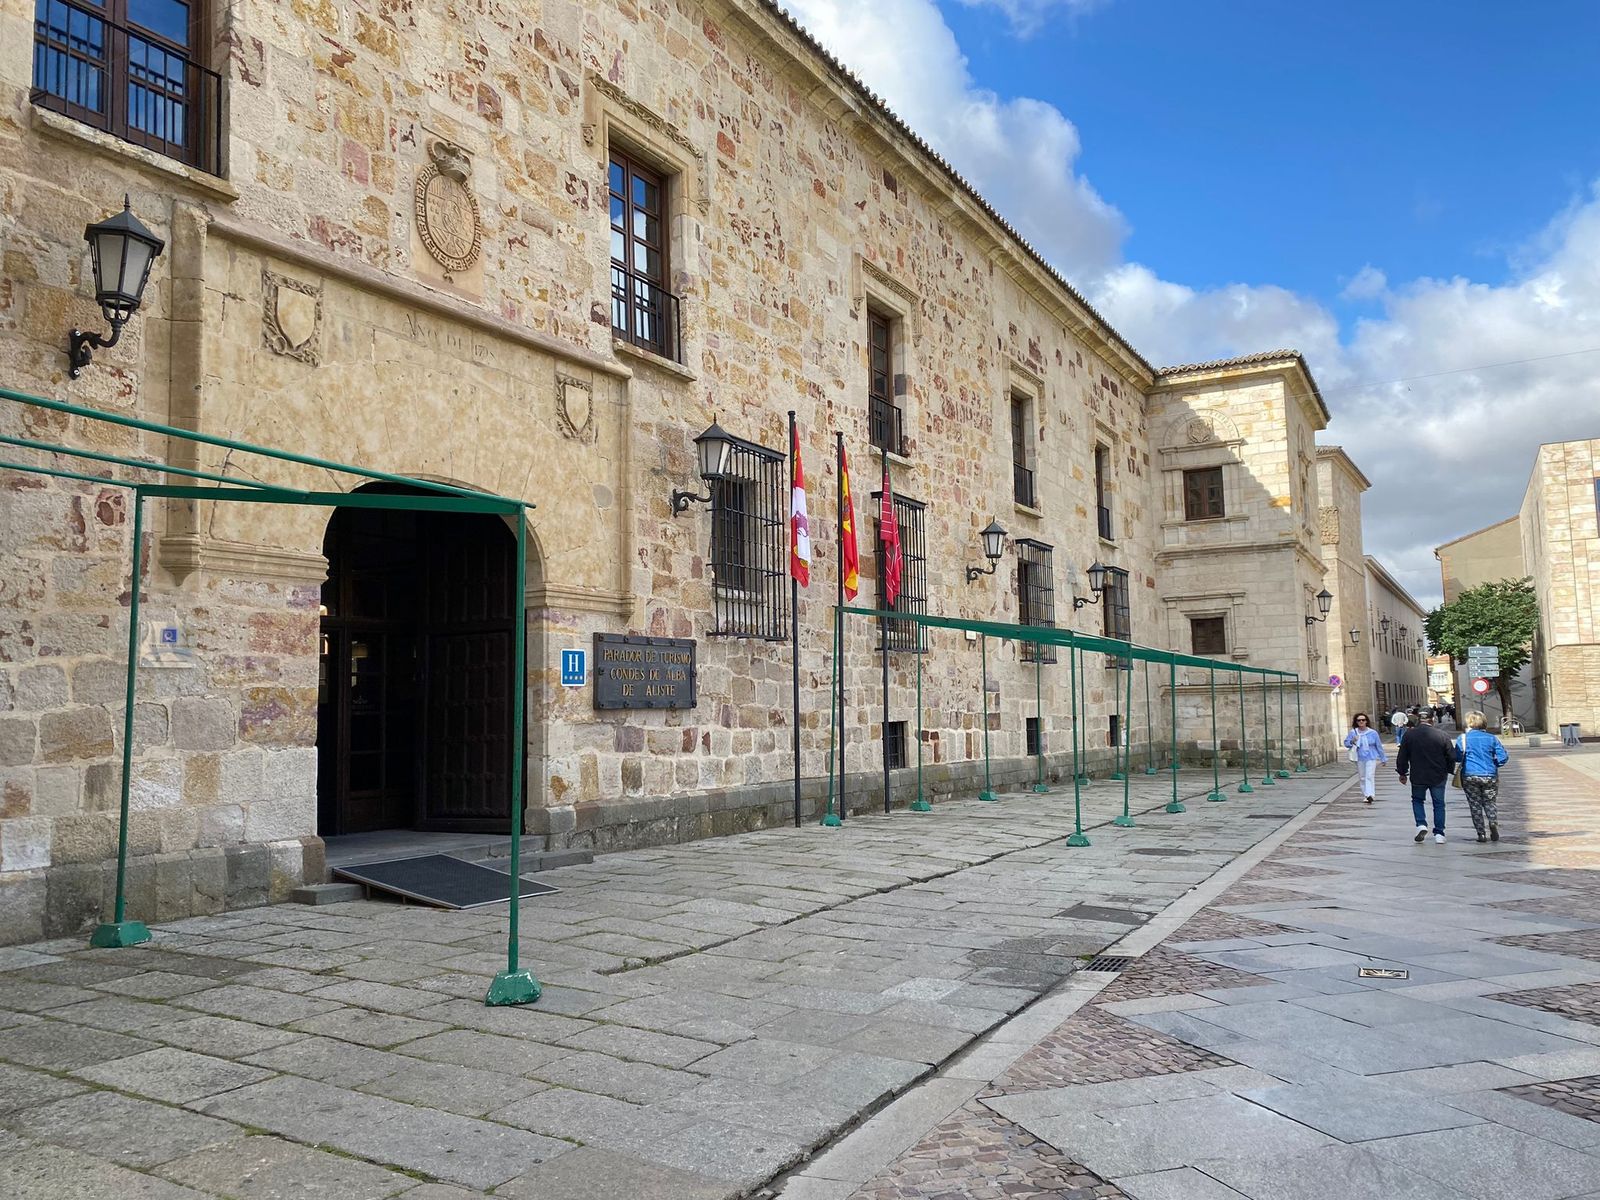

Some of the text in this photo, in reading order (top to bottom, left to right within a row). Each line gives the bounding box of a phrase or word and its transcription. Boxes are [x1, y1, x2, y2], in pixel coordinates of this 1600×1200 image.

[568, 654, 579, 672] H
[603, 648, 691, 664] PARADOR DE TURISMO
[610, 667, 687, 681] CONDES DE ALBA
[622, 684, 676, 697] DE ALISTE
